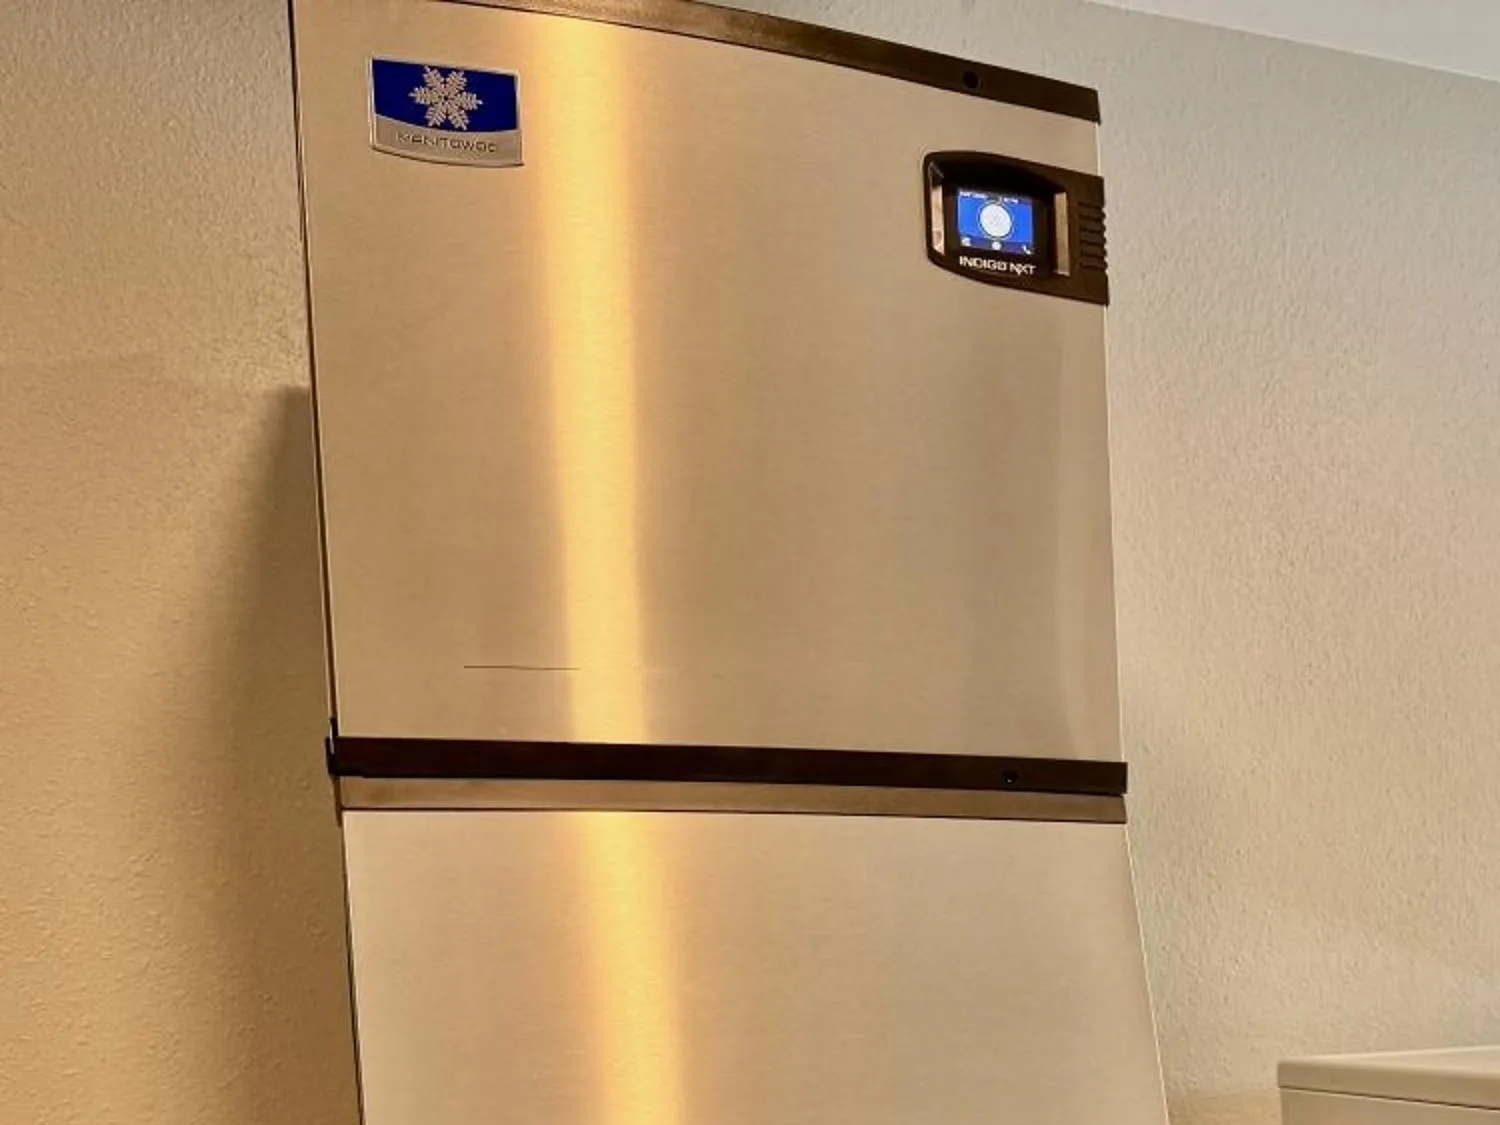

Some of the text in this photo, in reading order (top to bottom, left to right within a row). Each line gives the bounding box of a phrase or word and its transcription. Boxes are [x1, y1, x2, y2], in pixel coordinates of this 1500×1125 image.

[397, 132, 497, 153] MANITOWOC
[959, 255, 1037, 276] INDIGO NXT
